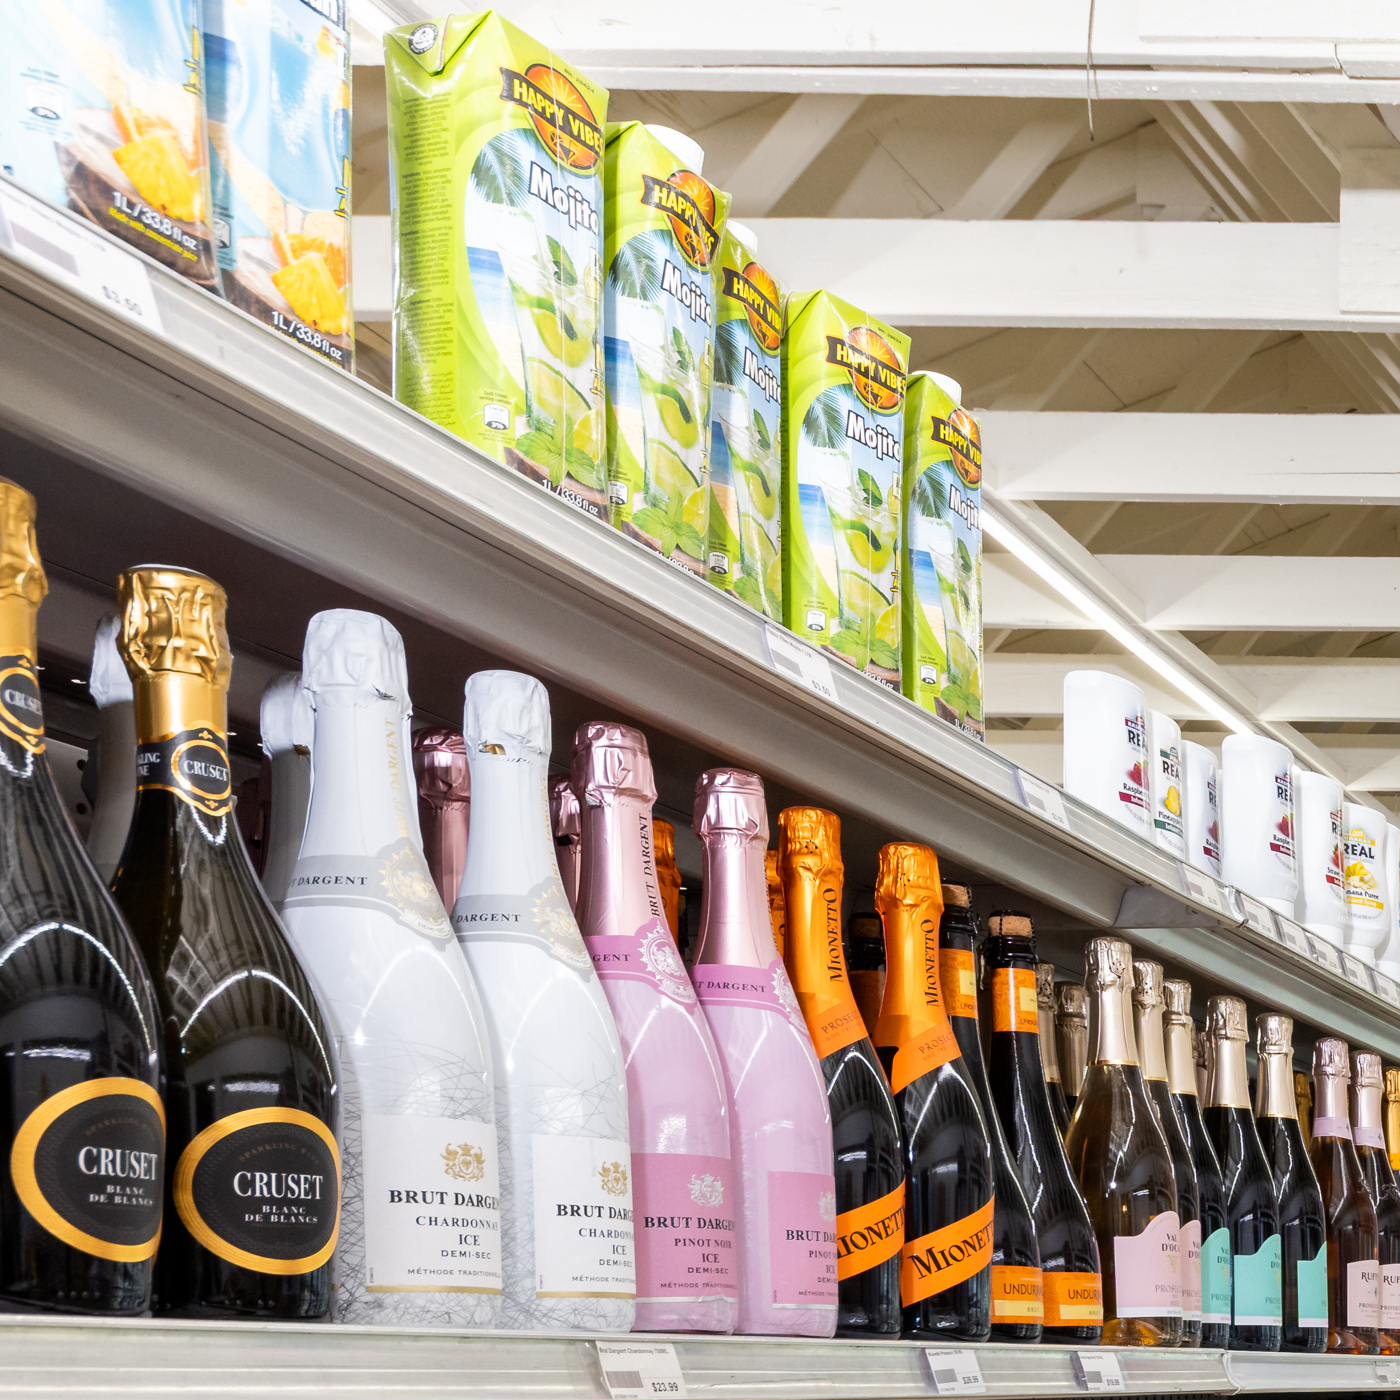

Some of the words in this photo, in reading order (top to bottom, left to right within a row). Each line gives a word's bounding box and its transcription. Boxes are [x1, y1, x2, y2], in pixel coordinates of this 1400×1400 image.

[513, 78, 565, 127] HAPPY
[569, 113, 603, 157] VIBES
[183, 760, 228, 782] CRUSET
[639, 814, 653, 881] DARGENT
[297, 874, 368, 888] DARGENT
[649, 883, 661, 916] BRUT
[77, 1146, 159, 1182] CRUSET
[232, 1171, 324, 1201] CRUSET
[261, 1205, 307, 1216] BLANC
[245, 1213, 263, 1224] DE
[268, 1215, 318, 1226] BLANCS
[643, 1216, 688, 1230] BRUT
[458, 1233, 481, 1247] ICE
[674, 1238, 702, 1249] PINOT
[705, 1239, 732, 1250] NOIR
[440, 1250, 492, 1260] DEMI-SEC
[652, 1381, 679, 1392] $23.99
